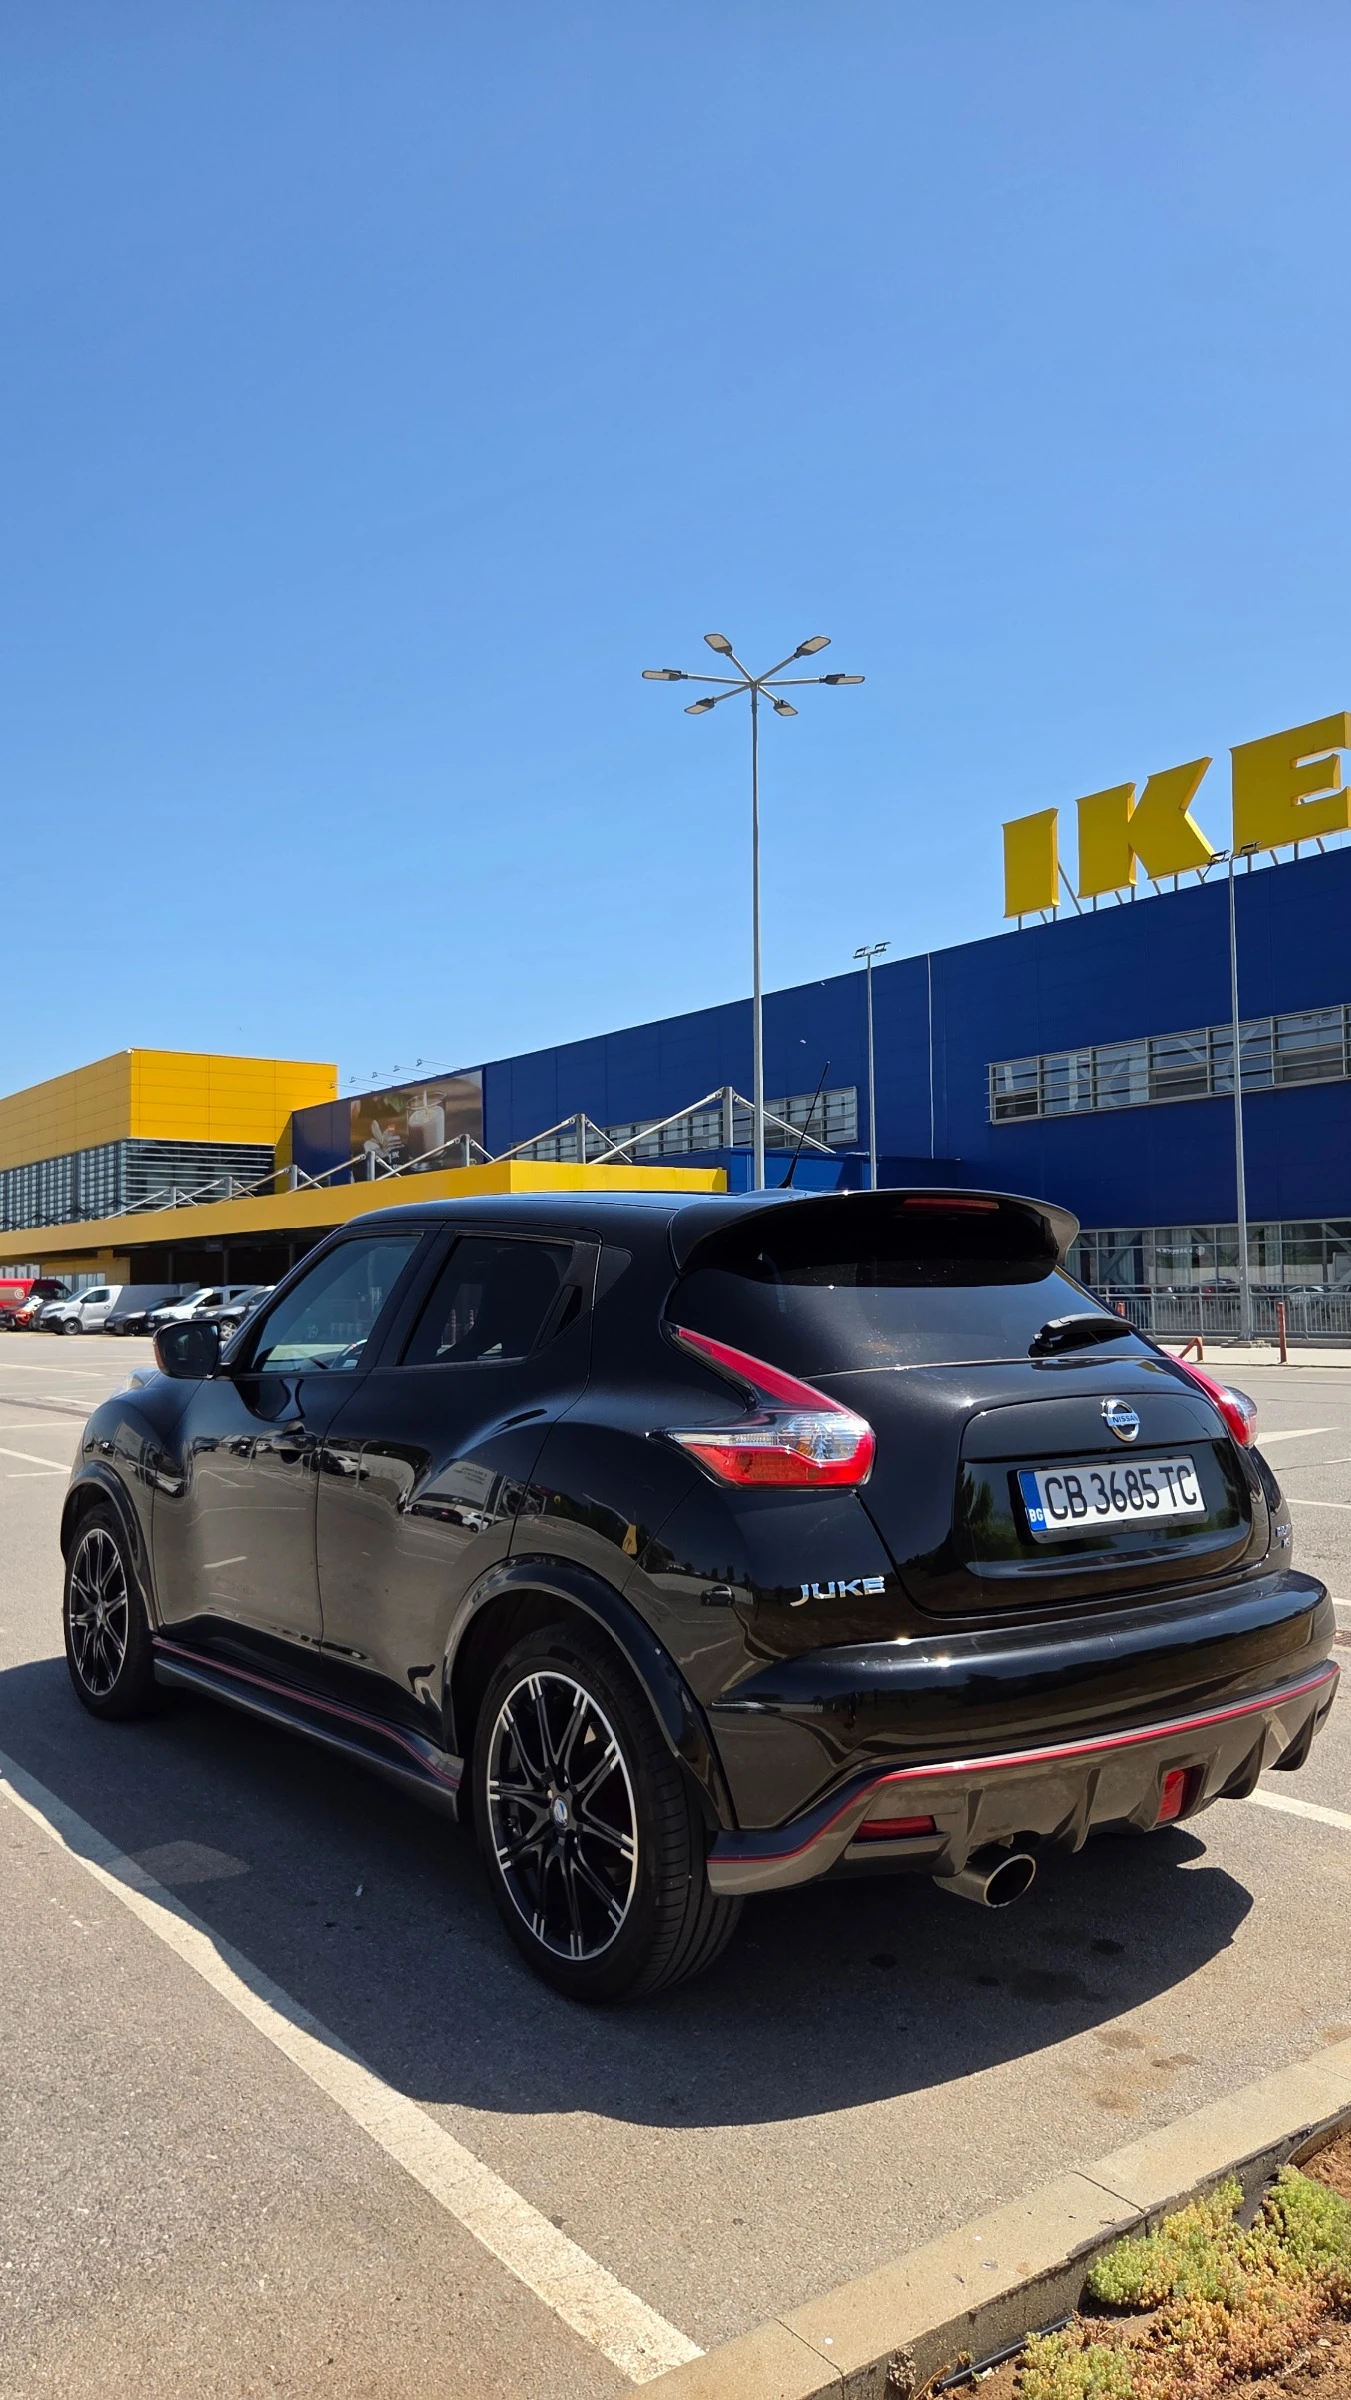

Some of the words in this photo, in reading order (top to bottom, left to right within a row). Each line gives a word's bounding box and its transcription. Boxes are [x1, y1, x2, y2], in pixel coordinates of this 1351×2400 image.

[1044, 1475, 1088, 1520] CB
[1090, 1468, 1160, 1515] 3685
[1159, 1464, 1198, 1508] TC
[1028, 1507, 1045, 1523] BG
[789, 1575, 886, 1607] JUKE
